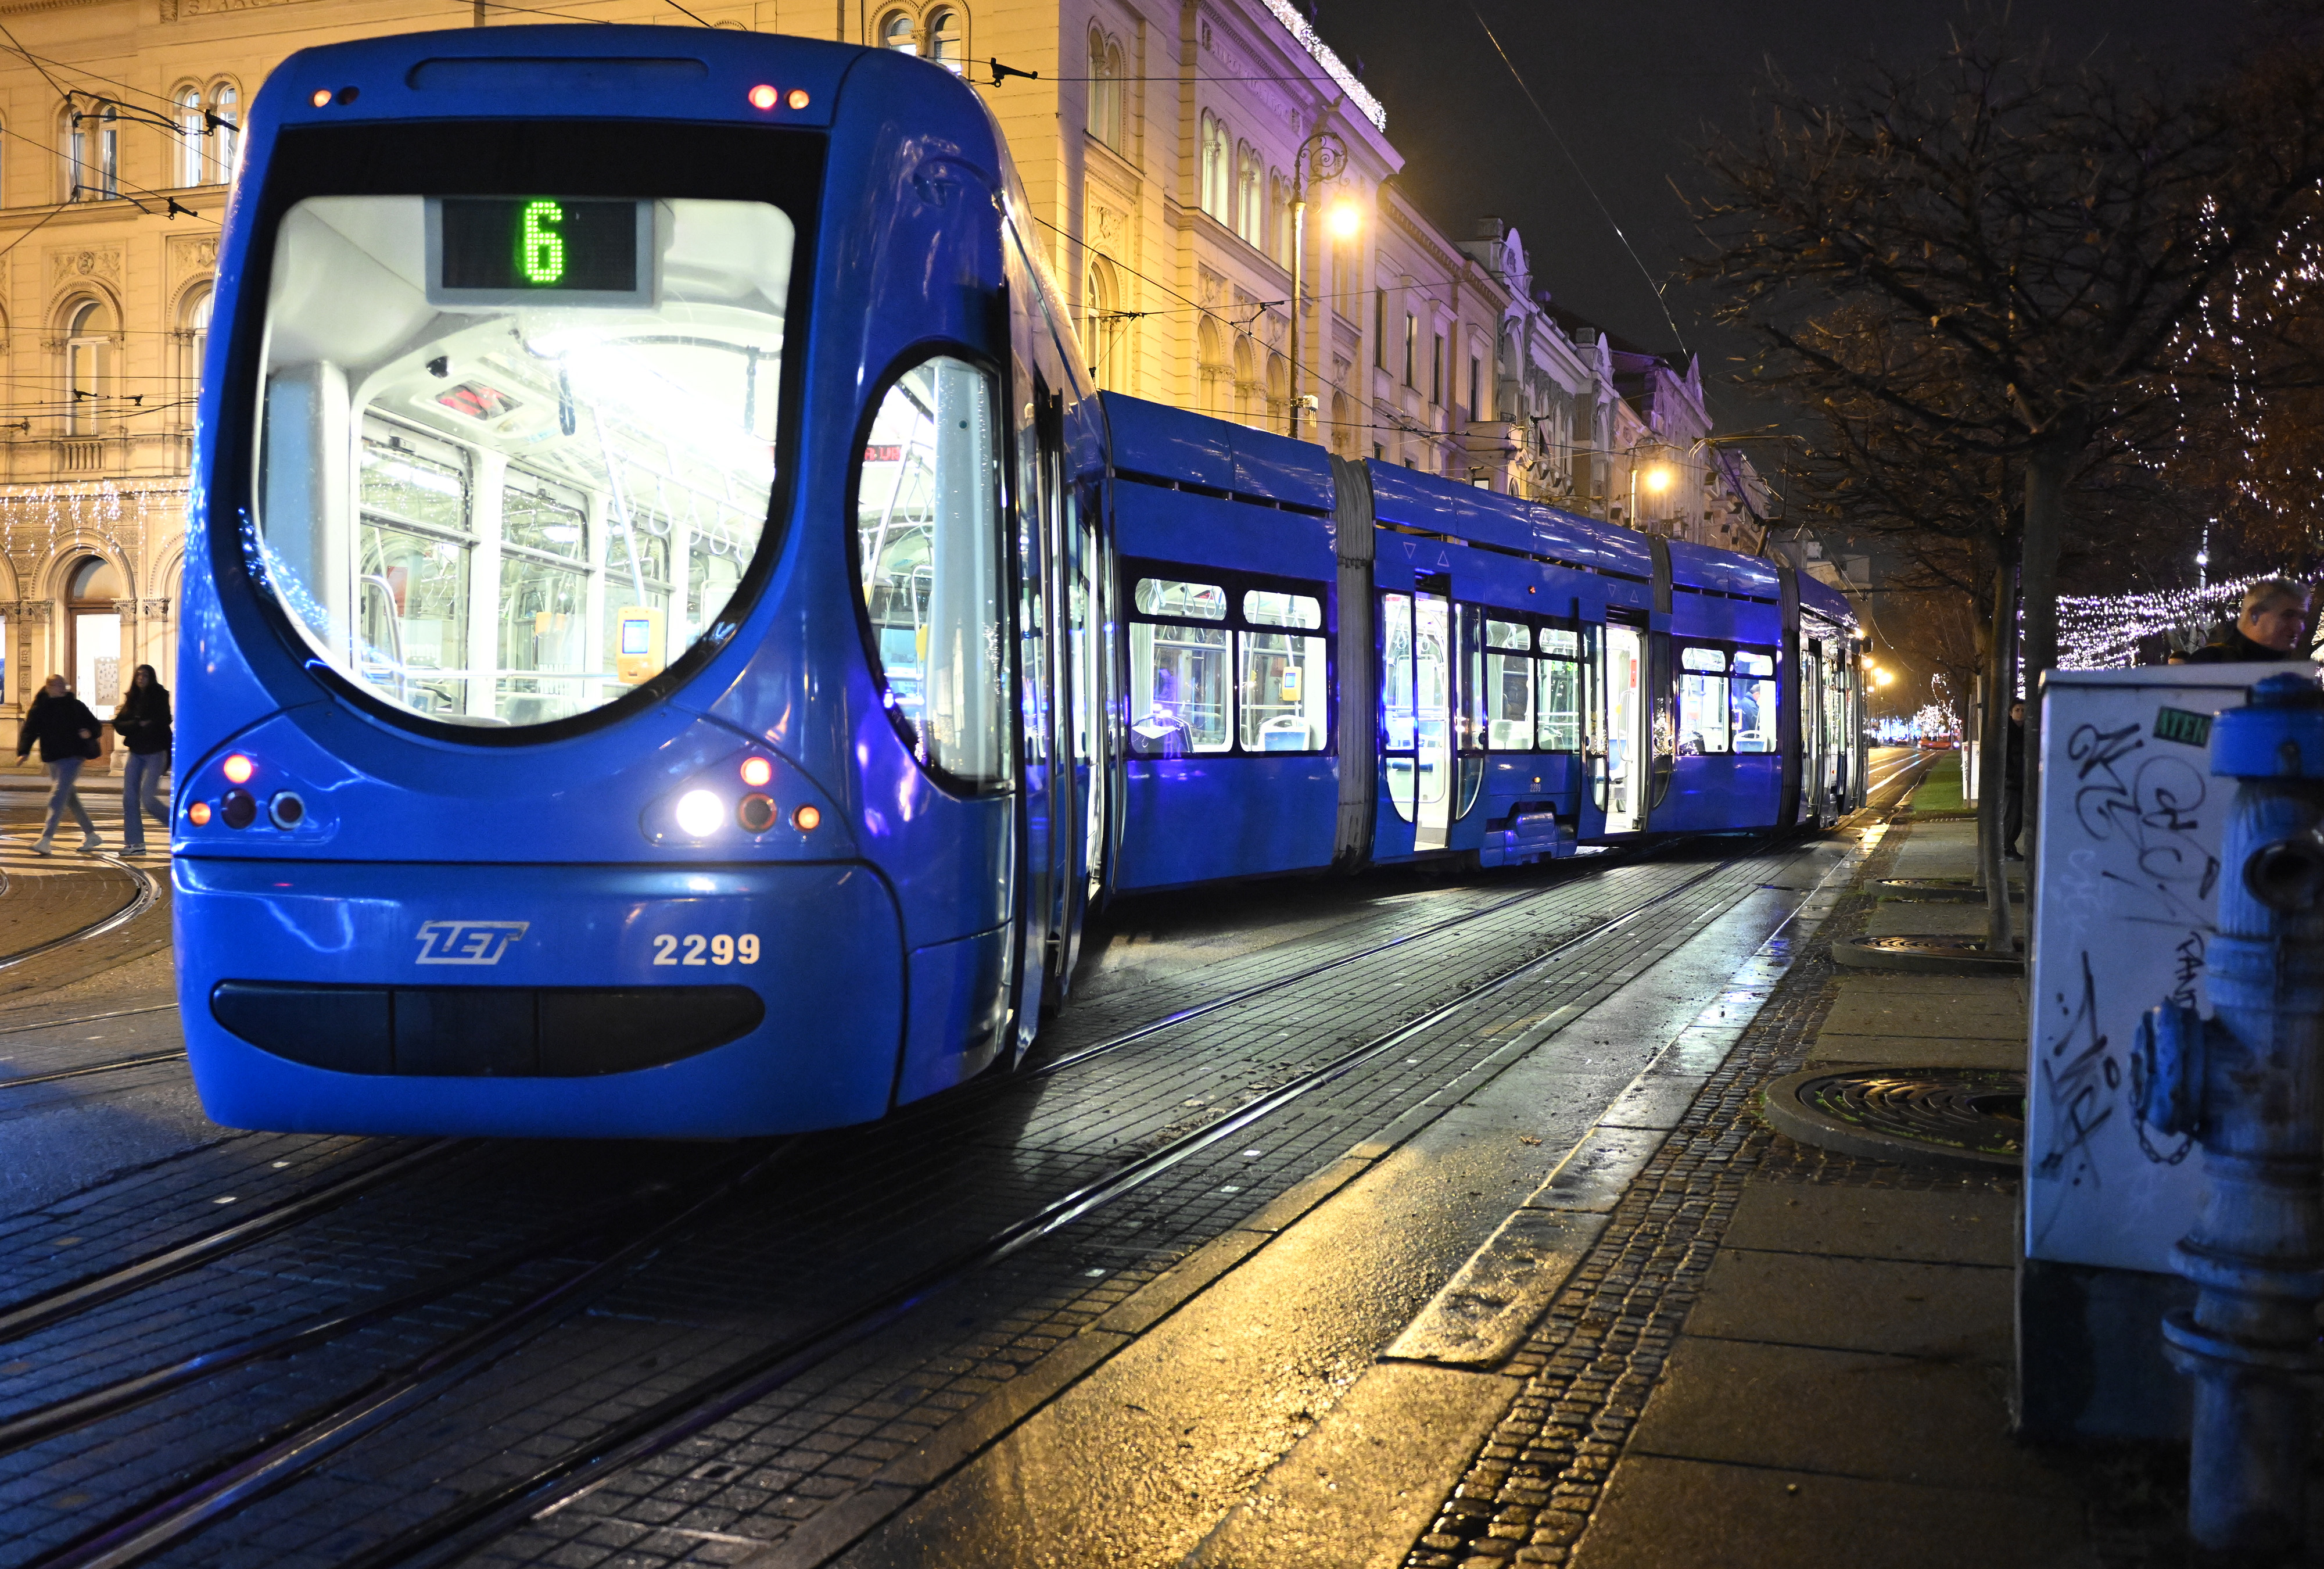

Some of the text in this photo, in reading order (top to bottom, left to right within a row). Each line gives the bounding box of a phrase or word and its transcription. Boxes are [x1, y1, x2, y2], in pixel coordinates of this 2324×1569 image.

[526, 201, 562, 282] 6
[1530, 783, 1541, 792] 2299
[415, 920, 530, 965] ZET
[652, 934, 761, 965] 2299
